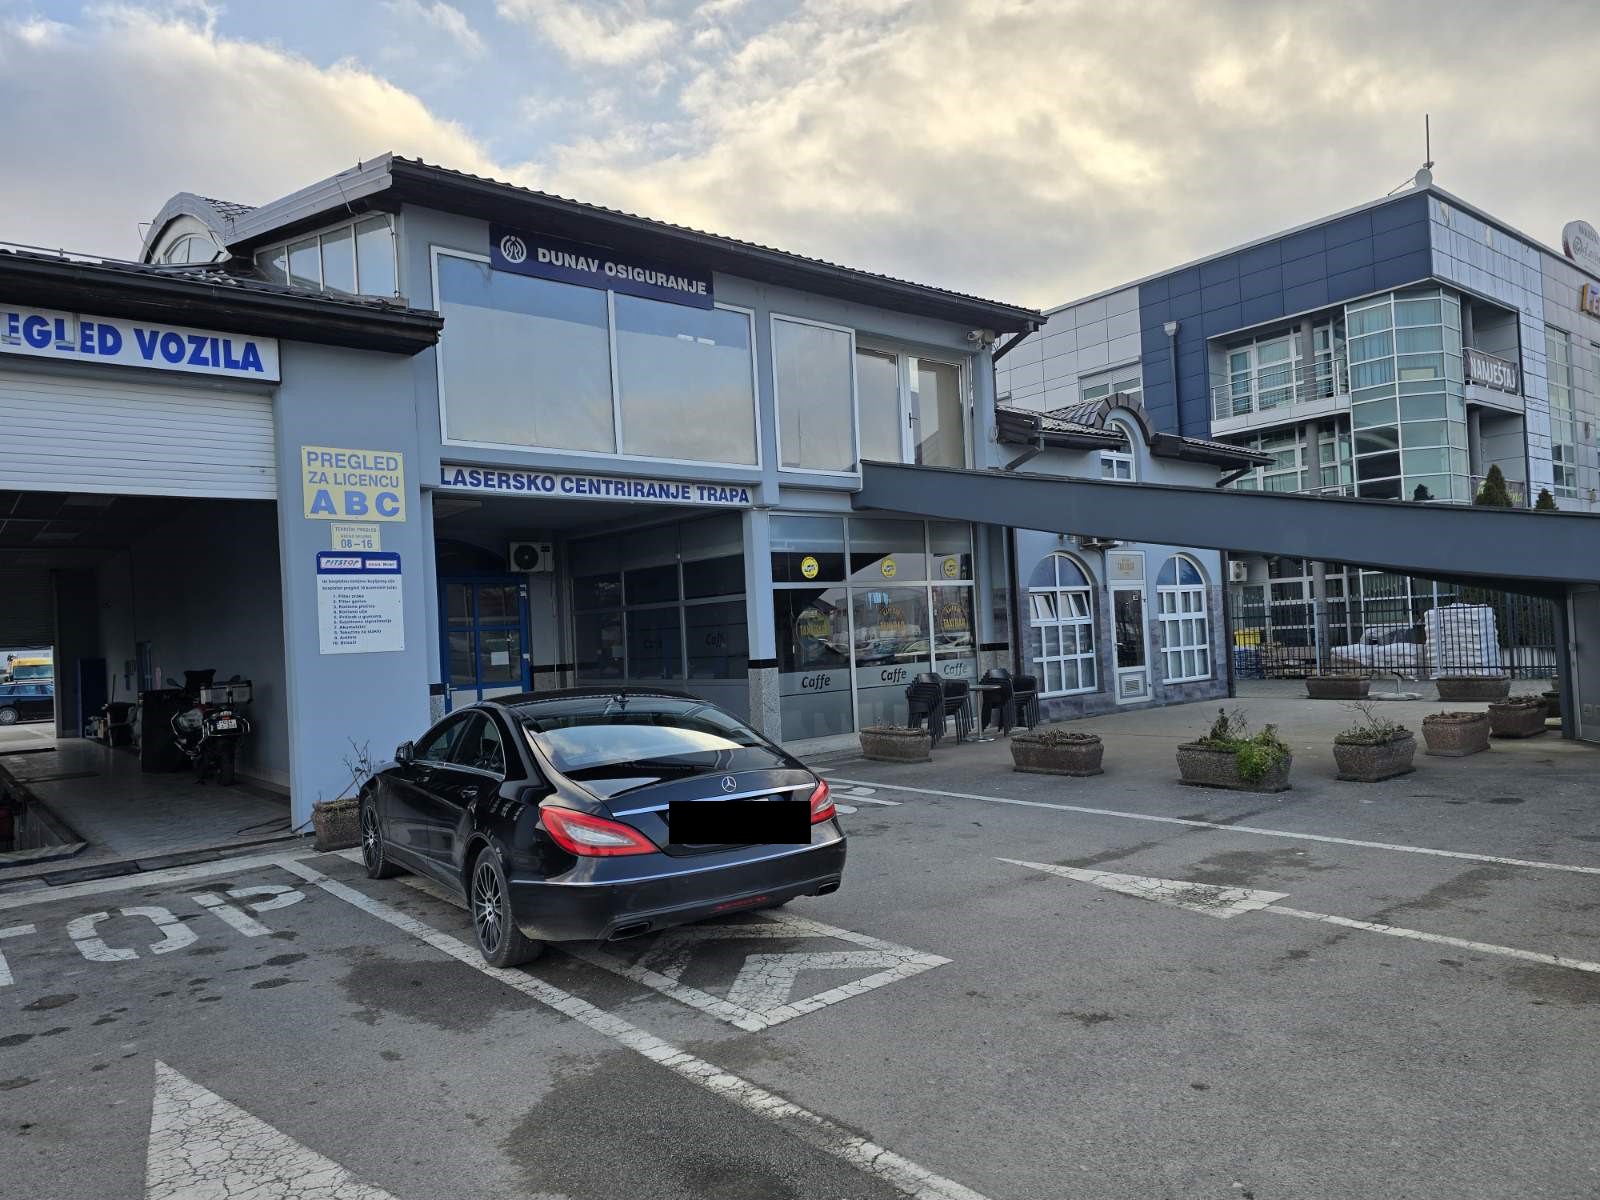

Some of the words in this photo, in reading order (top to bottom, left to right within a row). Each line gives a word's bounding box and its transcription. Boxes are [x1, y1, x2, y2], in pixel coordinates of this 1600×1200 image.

[537, 247, 599, 272] DUNAV
[604, 262, 707, 295] OSIGURANJE
[133, 328, 265, 373] VOZILA
[306, 451, 398, 471] PREGLED
[308, 471, 329, 484] ZA
[334, 473, 399, 488] LICENCU
[440, 467, 556, 492] LASERSKO
[560, 477, 691, 500] CENTRIRANJE
[697, 485, 750, 504] TRAPA
[880, 667, 908, 683] Caffe
[943, 662, 968, 677] Caffe
[801, 674, 831, 689] Caffe
